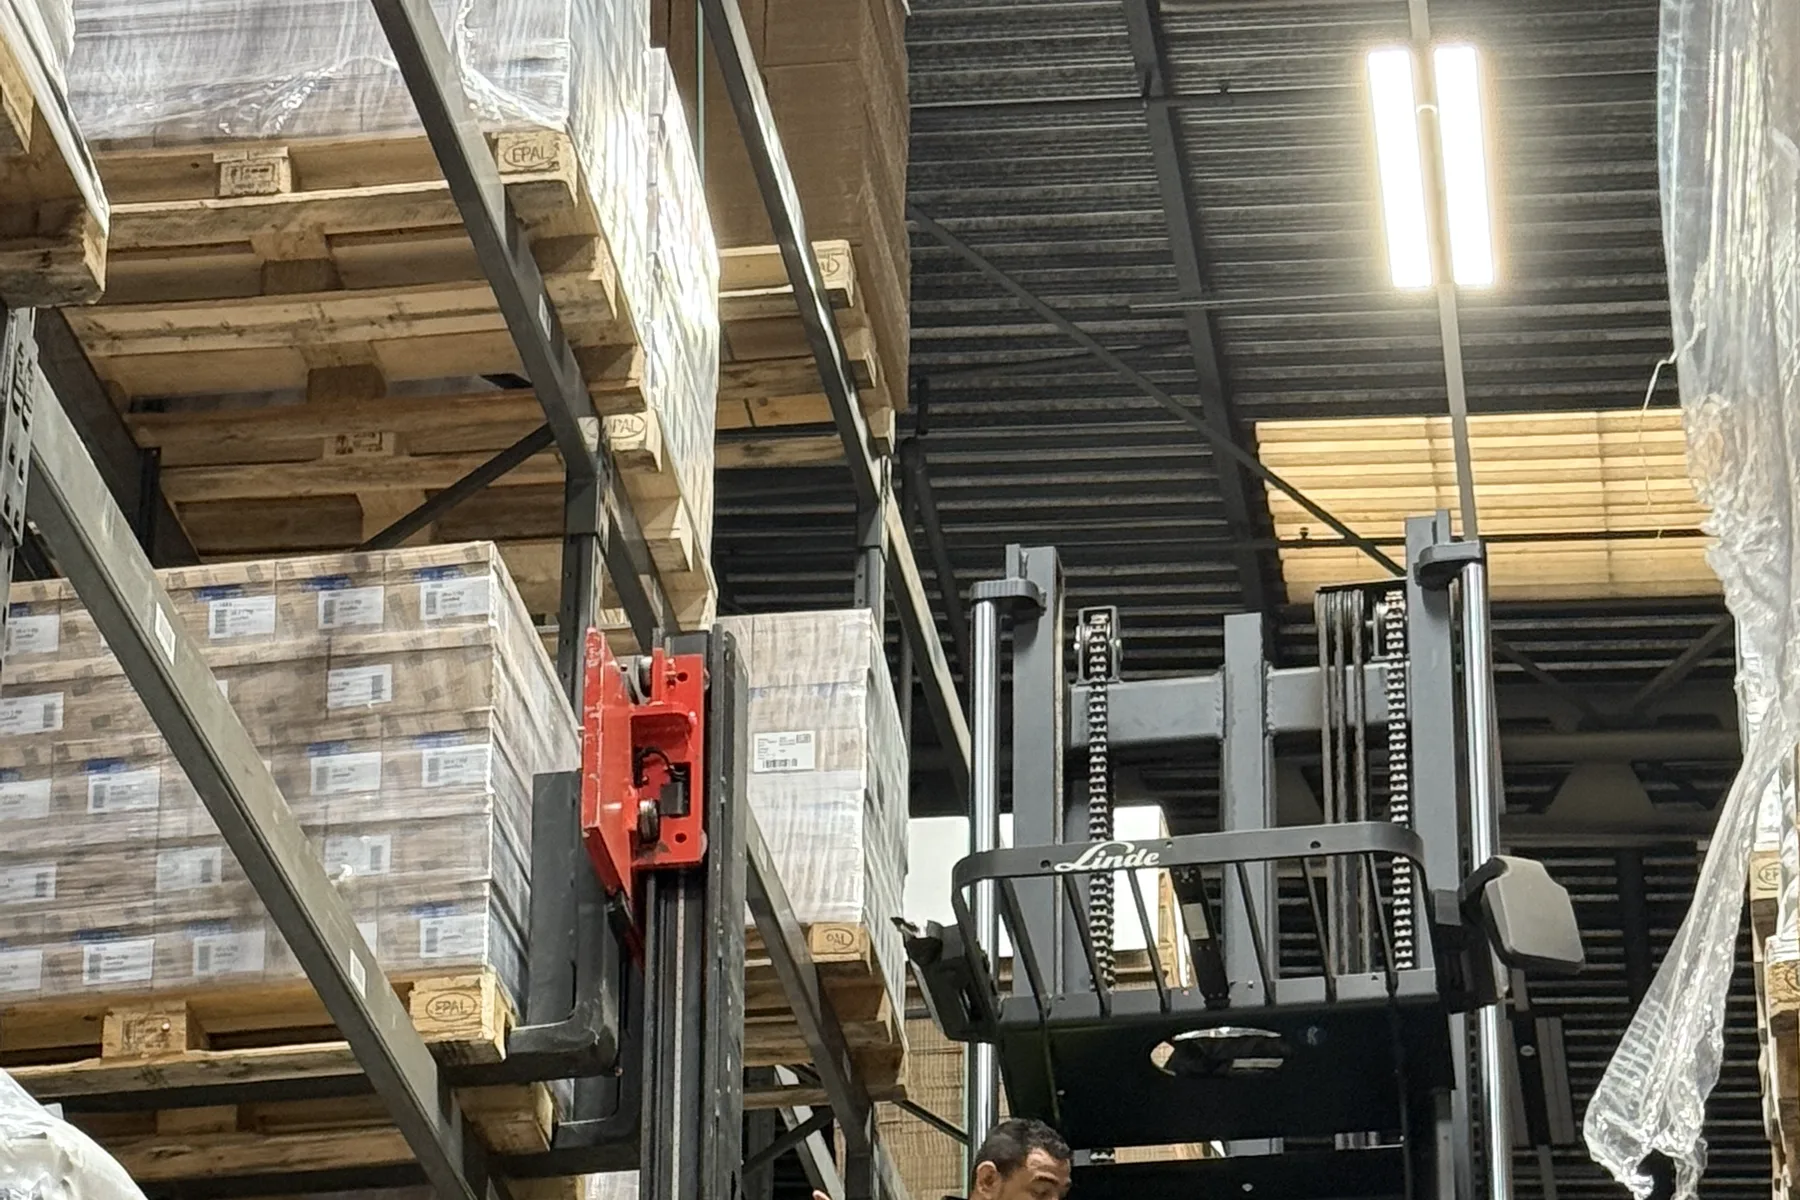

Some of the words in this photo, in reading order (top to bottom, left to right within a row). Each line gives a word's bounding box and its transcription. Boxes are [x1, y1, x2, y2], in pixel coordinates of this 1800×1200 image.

[512, 145, 549, 163] EPAL
[1054, 840, 1160, 872] Linde
[434, 1000, 468, 1016] EPAL
